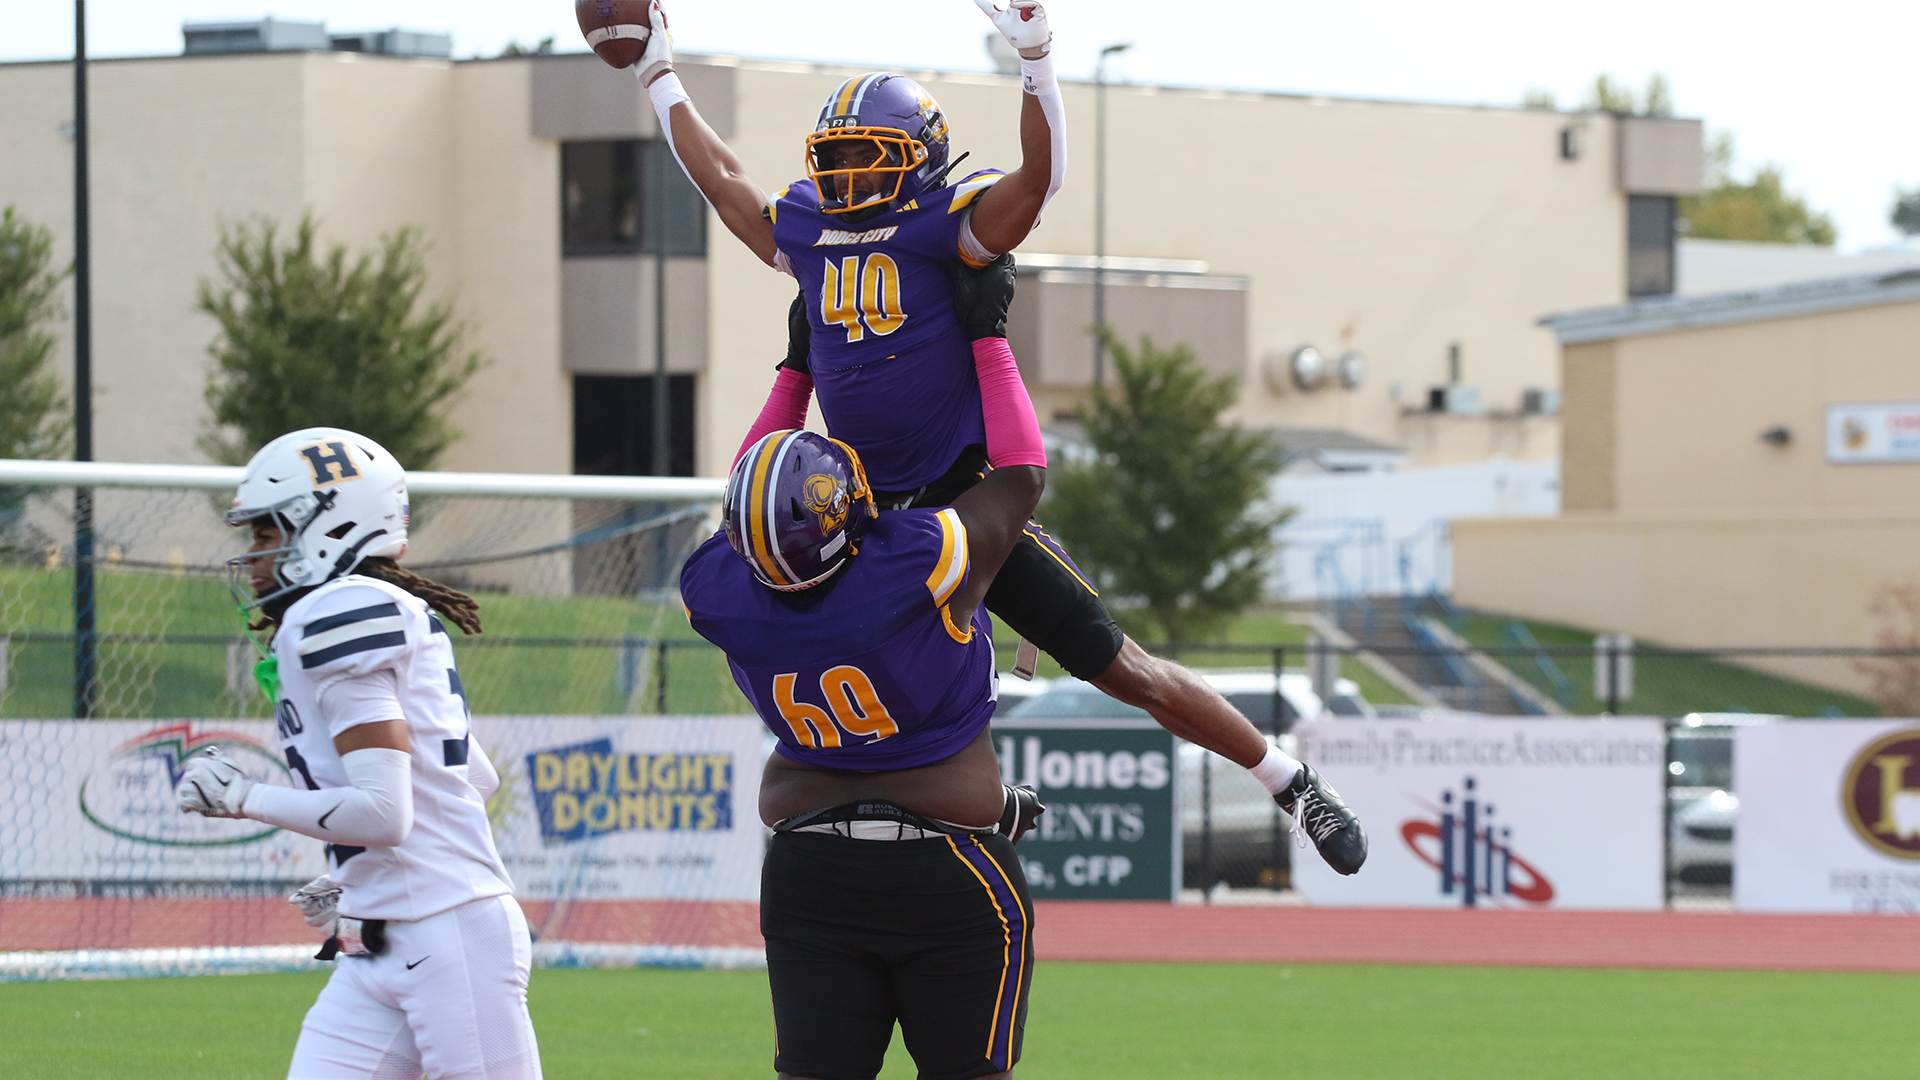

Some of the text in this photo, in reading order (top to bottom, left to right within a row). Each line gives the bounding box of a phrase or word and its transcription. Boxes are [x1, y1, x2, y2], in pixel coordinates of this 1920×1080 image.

[813, 225, 899, 247] DODGE CITY
[821, 252, 908, 343] 40
[298, 440, 362, 488] H
[534, 752, 731, 793] DAYLIGHT
[1020, 736, 1171, 791] Jones
[553, 793, 719, 831] DONUTS
[1062, 855, 1134, 887] CFP
